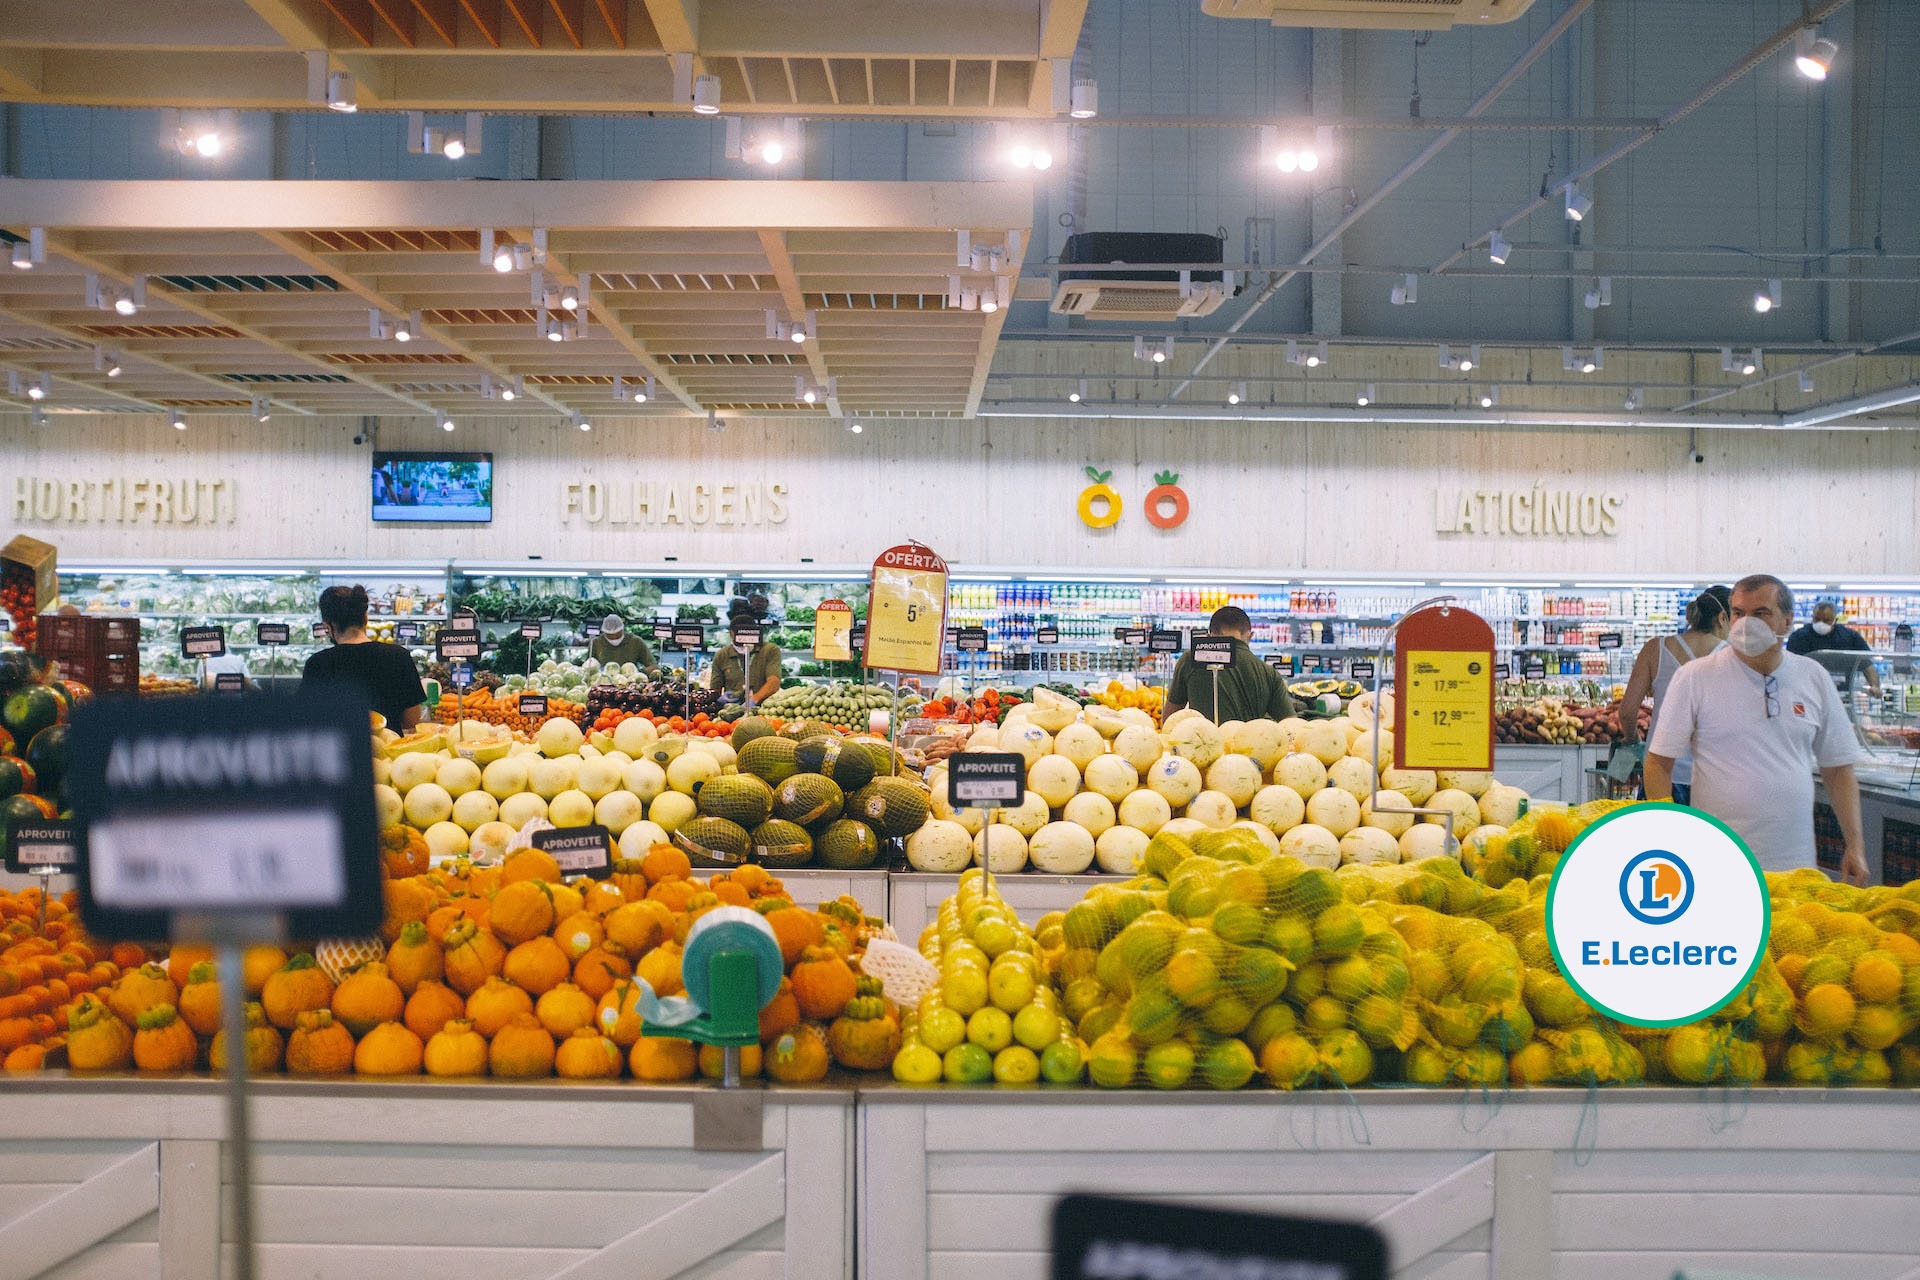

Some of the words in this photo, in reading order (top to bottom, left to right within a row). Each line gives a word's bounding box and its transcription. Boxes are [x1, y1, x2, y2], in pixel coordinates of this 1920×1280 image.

[13, 478, 240, 524] HORTIFRUTI
[559, 480, 790, 525] FOLHAGENS
[1434, 479, 1624, 537] LATICÍNIOS
[884, 551, 942, 569] OFERTA
[821, 603, 849, 611] OFERTA
[907, 604, 917, 622] 5
[441, 635, 477, 643] APROVEITE
[1195, 642, 1231, 650] APROVEITE
[1432, 709, 1462, 727] 12,99
[957, 763, 1017, 773] APROVEITE
[16, 829, 77, 839] APROVEIT
[542, 835, 602, 850] APROVEITE
